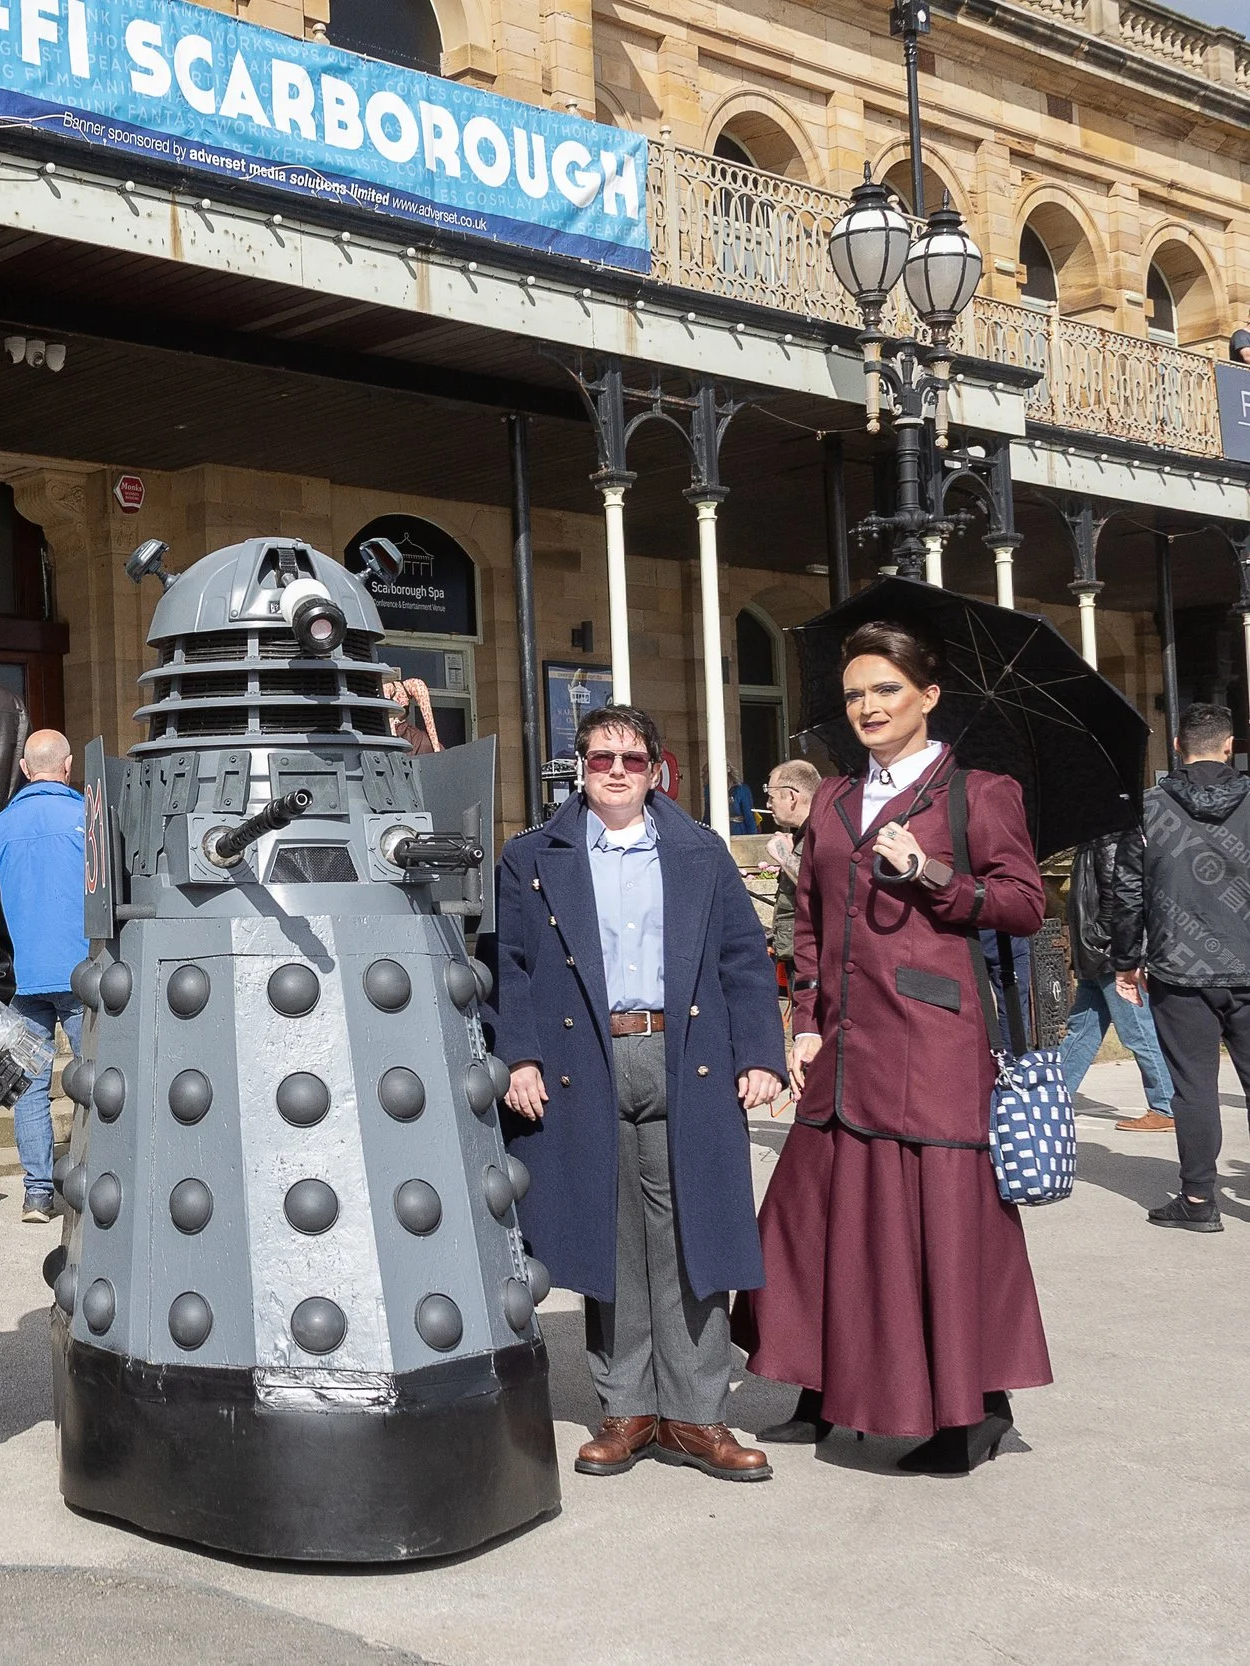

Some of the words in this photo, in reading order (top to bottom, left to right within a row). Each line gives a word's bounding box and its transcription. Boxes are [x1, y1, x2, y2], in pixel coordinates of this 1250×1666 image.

[0, 41, 62, 64] GUST
[24, 67, 82, 89] FILMS
[126, 19, 639, 219] SCARBOROUGH
[128, 104, 208, 130] FANTASY
[63, 111, 105, 136] Banner
[107, 127, 170, 153] sponsored
[173, 140, 187, 161] by
[189, 148, 247, 172] adverset
[249, 162, 286, 182] media
[289, 172, 347, 195] solutions
[350, 181, 390, 206] limited
[392, 196, 487, 231] www.adverset.co.uk
[324, 152, 389, 174] ARTISTS
[465, 190, 532, 211] COSPLAY
[121, 482, 142, 491] Monks
[428, 586, 445, 601] Spa
[432, 604, 446, 612] Venue
